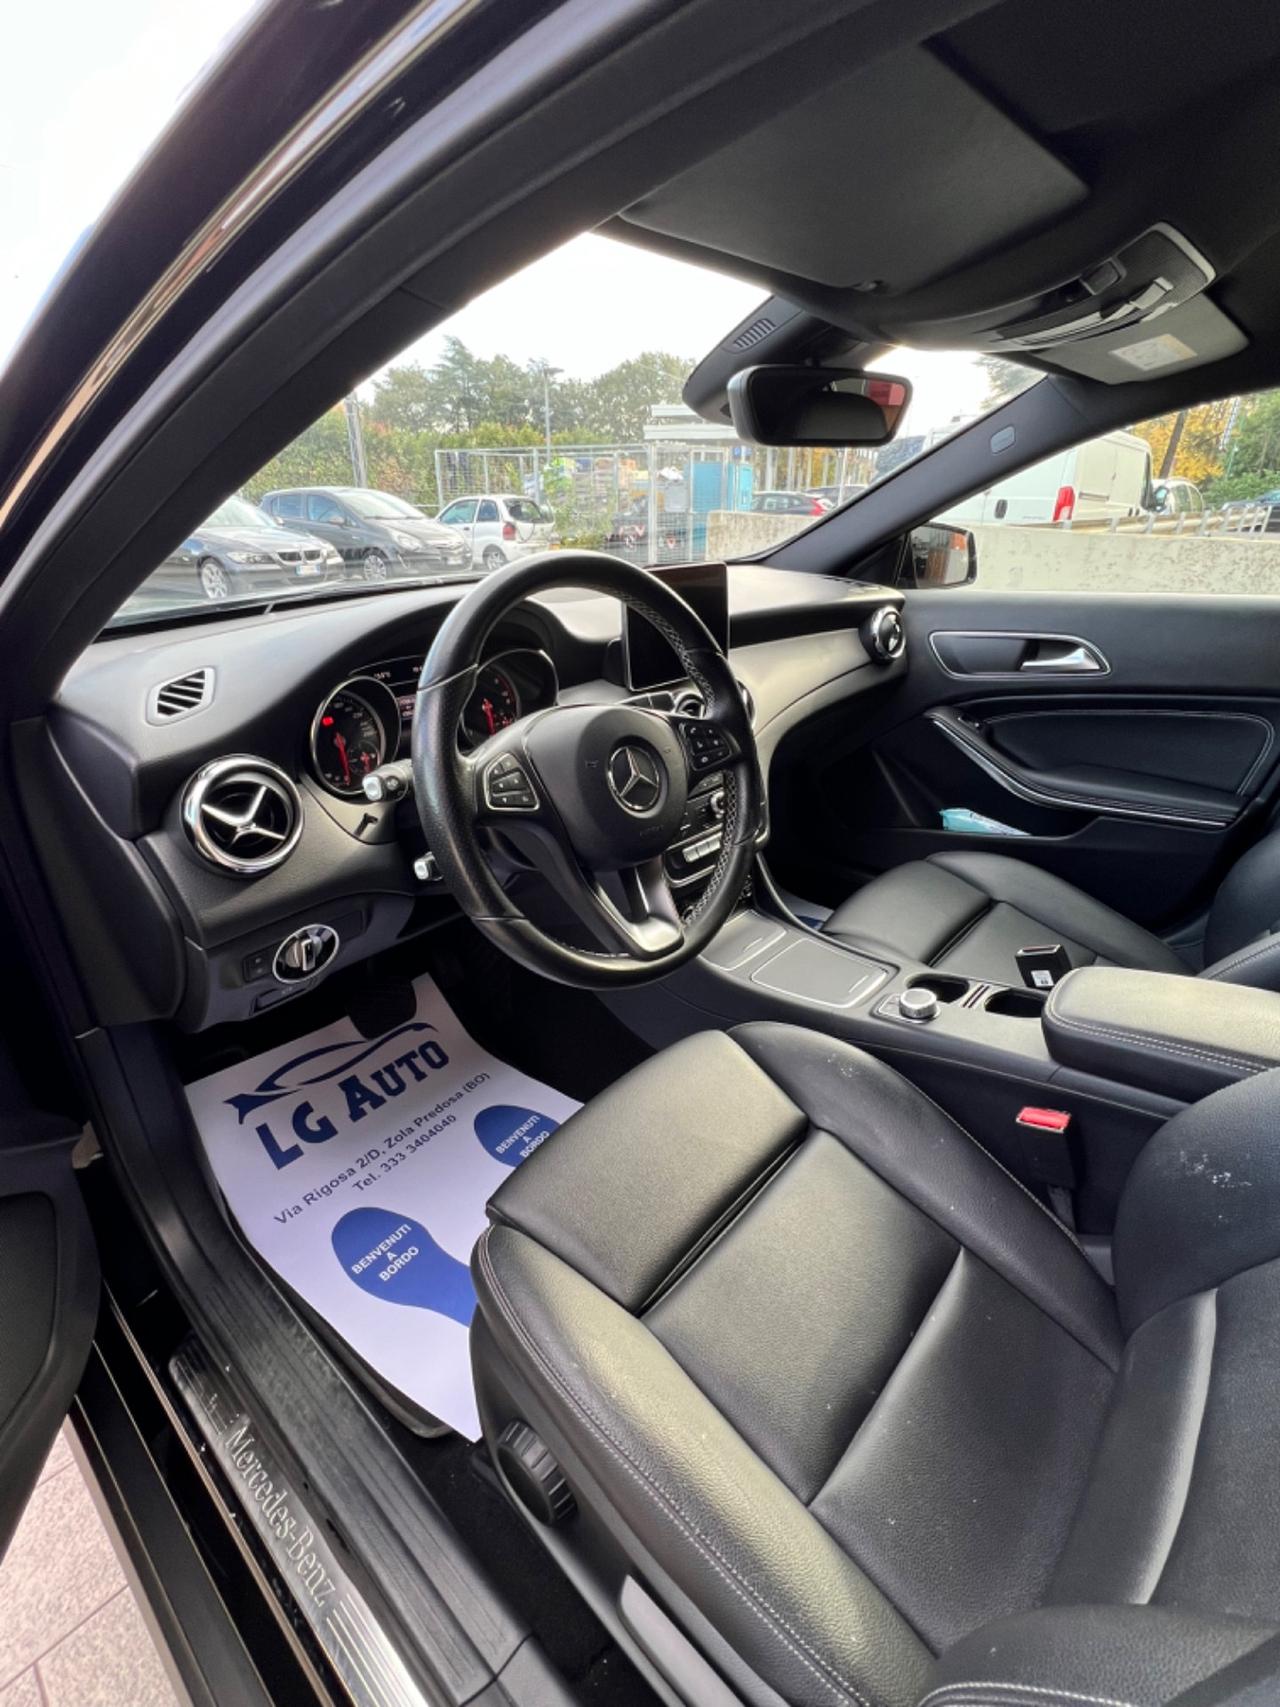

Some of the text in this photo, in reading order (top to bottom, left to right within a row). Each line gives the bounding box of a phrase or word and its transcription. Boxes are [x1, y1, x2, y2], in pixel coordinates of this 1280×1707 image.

[256, 1040, 449, 1171] LG AUTO
[273, 1072, 492, 1224] Via Rigosa 2/D, Zola Predosa (BO)
[352, 1114, 457, 1192] Tel. 333 3404040
[495, 1114, 541, 1154] BENVENUTI
[520, 1130, 550, 1158] BORDO
[523, 1135, 533, 1144] A
[351, 1223, 412, 1274] BENVENUTI
[378, 1245, 420, 1282] BORDO
[387, 1251, 398, 1262] A
[225, 1423, 336, 1607] Mercedes-Benz
